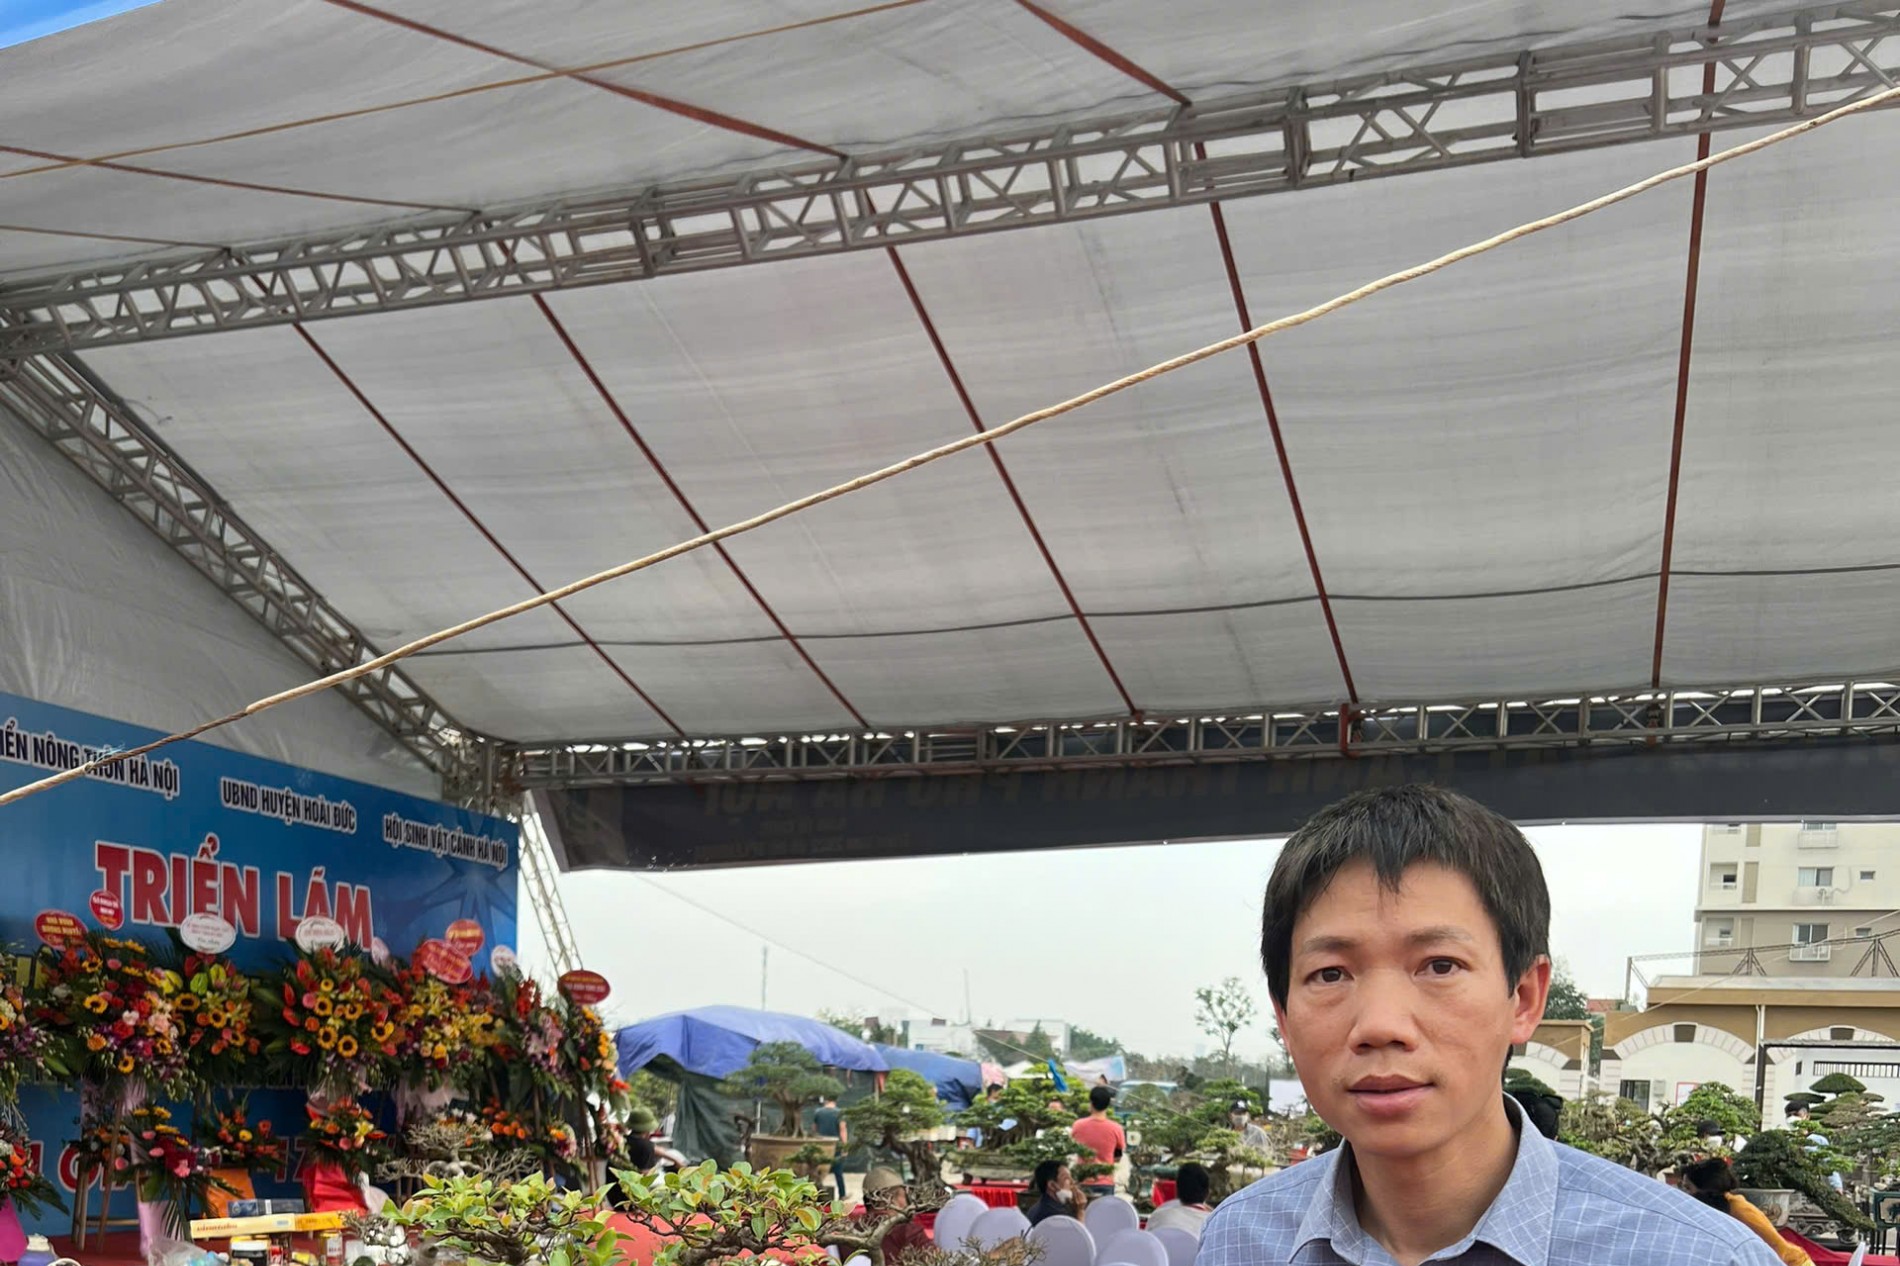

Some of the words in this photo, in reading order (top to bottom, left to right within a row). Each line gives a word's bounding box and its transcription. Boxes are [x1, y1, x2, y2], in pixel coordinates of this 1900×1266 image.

[32, 732, 80, 771] NÔNG
[128, 752, 150, 787] HÀ
[152, 759, 180, 798] NỘI
[222, 779, 258, 811] UBND
[261, 788, 300, 823] HUYỆN
[303, 795, 330, 826] HOÀI
[333, 801, 356, 832] ĐỨC
[384, 813, 404, 847] HỘI
[405, 822, 429, 849] SINH
[430, 823, 449, 857] VẬT
[450, 827, 476, 858] CẢNH
[477, 836, 490, 861] HÀ
[491, 840, 508, 870] NỘI
[95, 833, 260, 937] TRIỂN
[277, 867, 373, 951] LÃM
